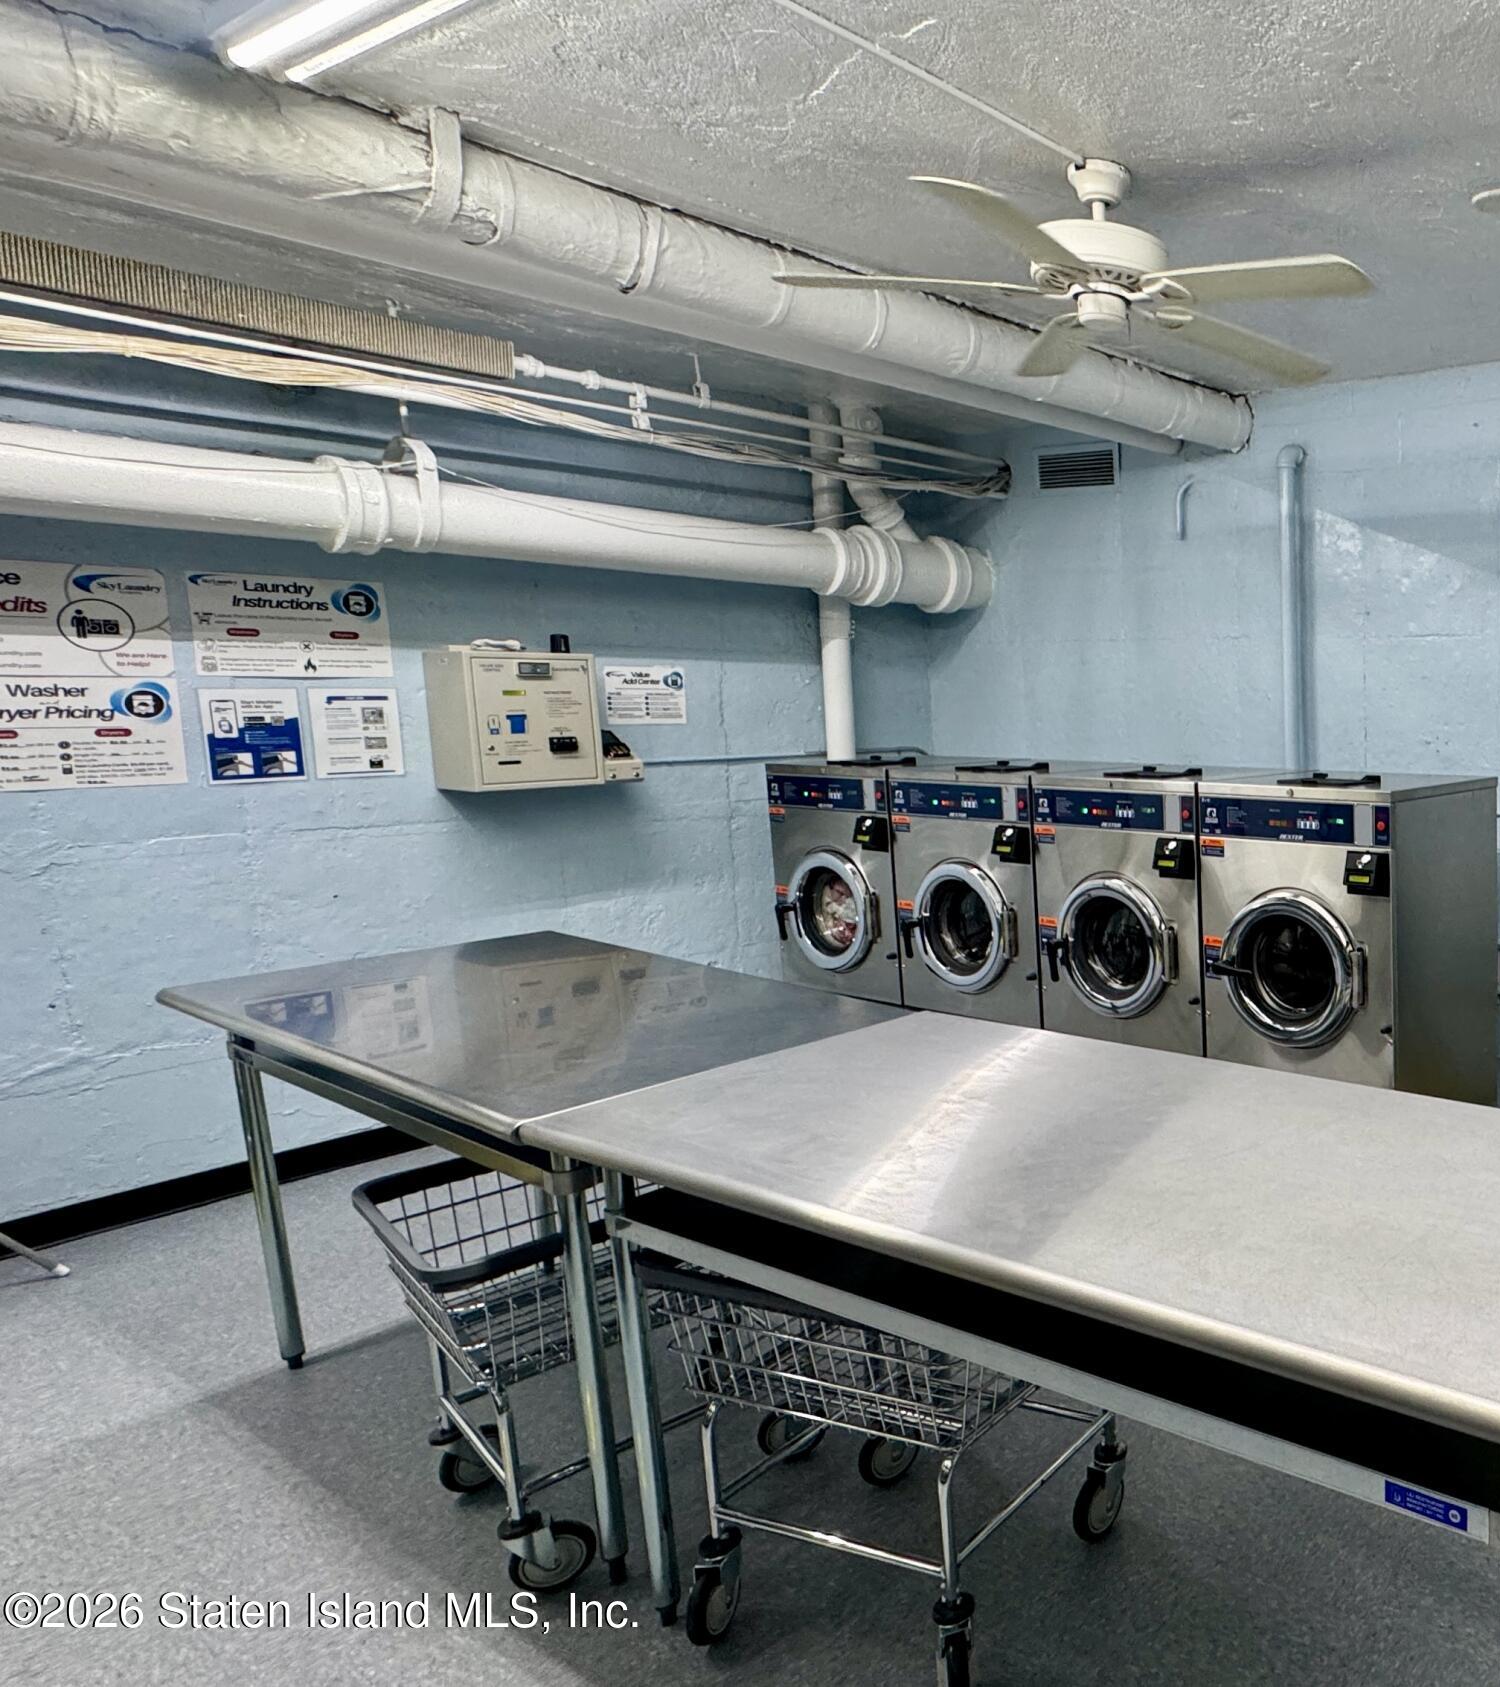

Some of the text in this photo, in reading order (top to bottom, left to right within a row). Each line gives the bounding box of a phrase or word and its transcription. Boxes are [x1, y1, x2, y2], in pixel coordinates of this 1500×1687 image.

[243, 580, 314, 598] Laundry
[0, 596, 48, 613] dits
[232, 595, 329, 611] Instructions
[5, 683, 89, 698] Washer
[45, 706, 115, 722] Pricing
